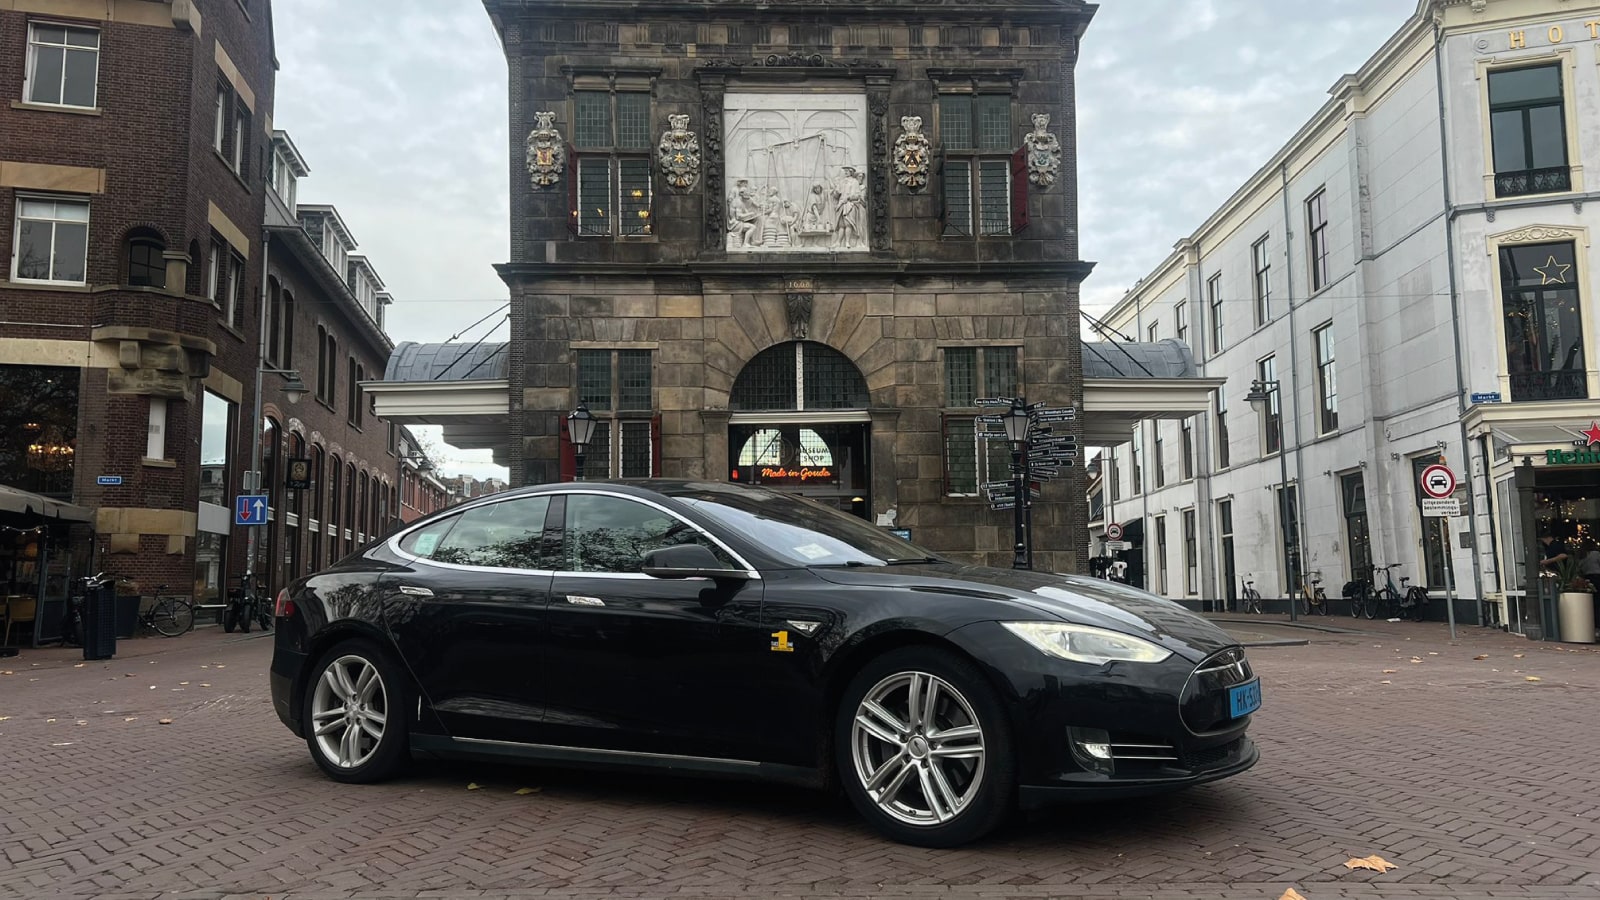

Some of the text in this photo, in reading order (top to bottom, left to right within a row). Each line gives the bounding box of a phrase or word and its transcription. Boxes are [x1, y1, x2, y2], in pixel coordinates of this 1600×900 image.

[1545, 449, 1600, 465] Hein
[761, 467, 831, 480] Made in Gouda
